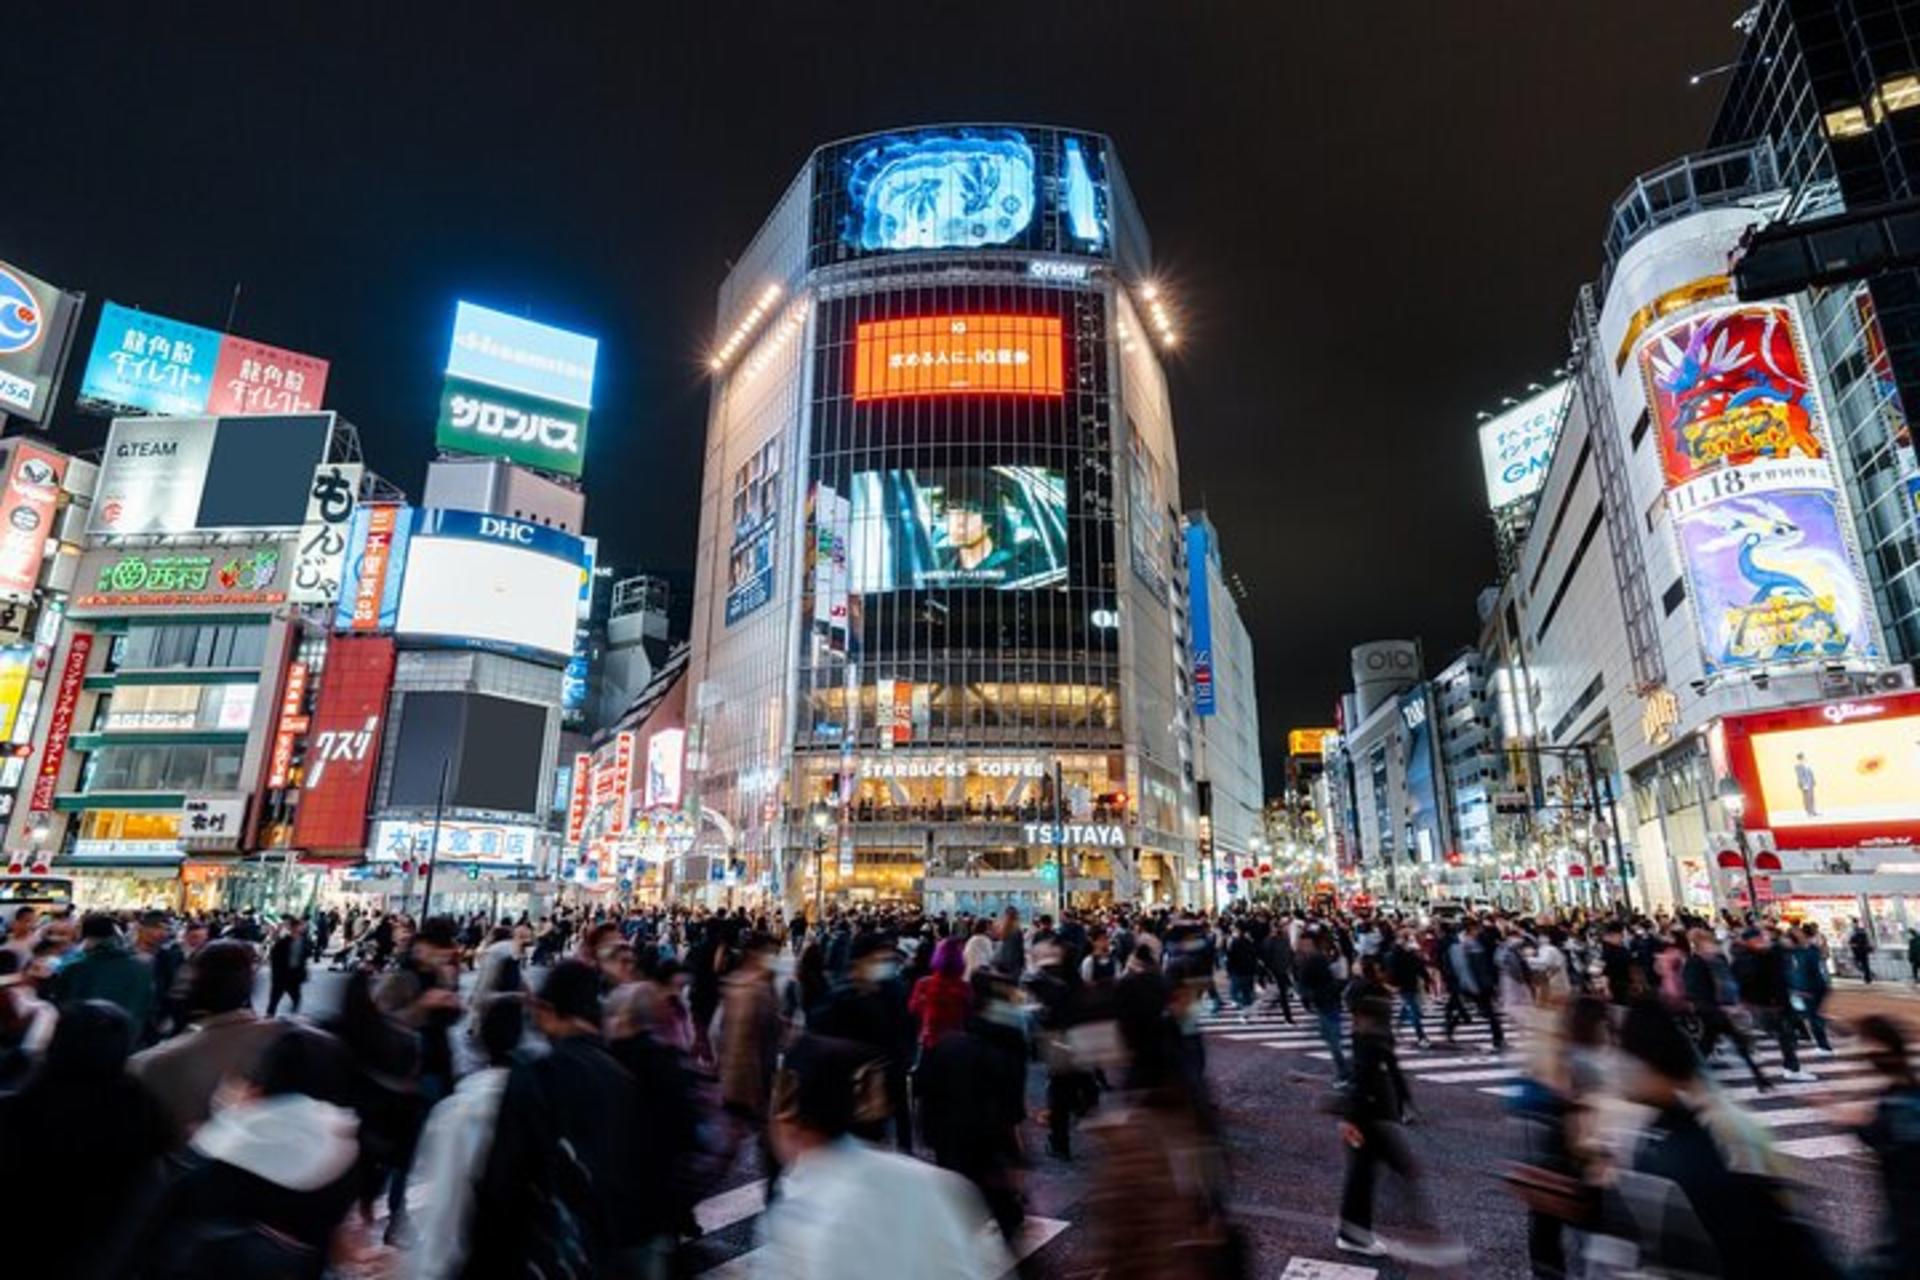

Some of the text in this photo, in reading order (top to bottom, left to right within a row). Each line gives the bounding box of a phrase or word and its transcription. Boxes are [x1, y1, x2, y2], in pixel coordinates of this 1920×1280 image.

[451, 395, 578, 454] サロンパス
[294, 467, 353, 599] もんじゃ
[480, 517, 534, 544] DHC
[862, 761, 1045, 778] STARBUCKS COFFEE
[1023, 823, 1126, 847] TSUTAYA
